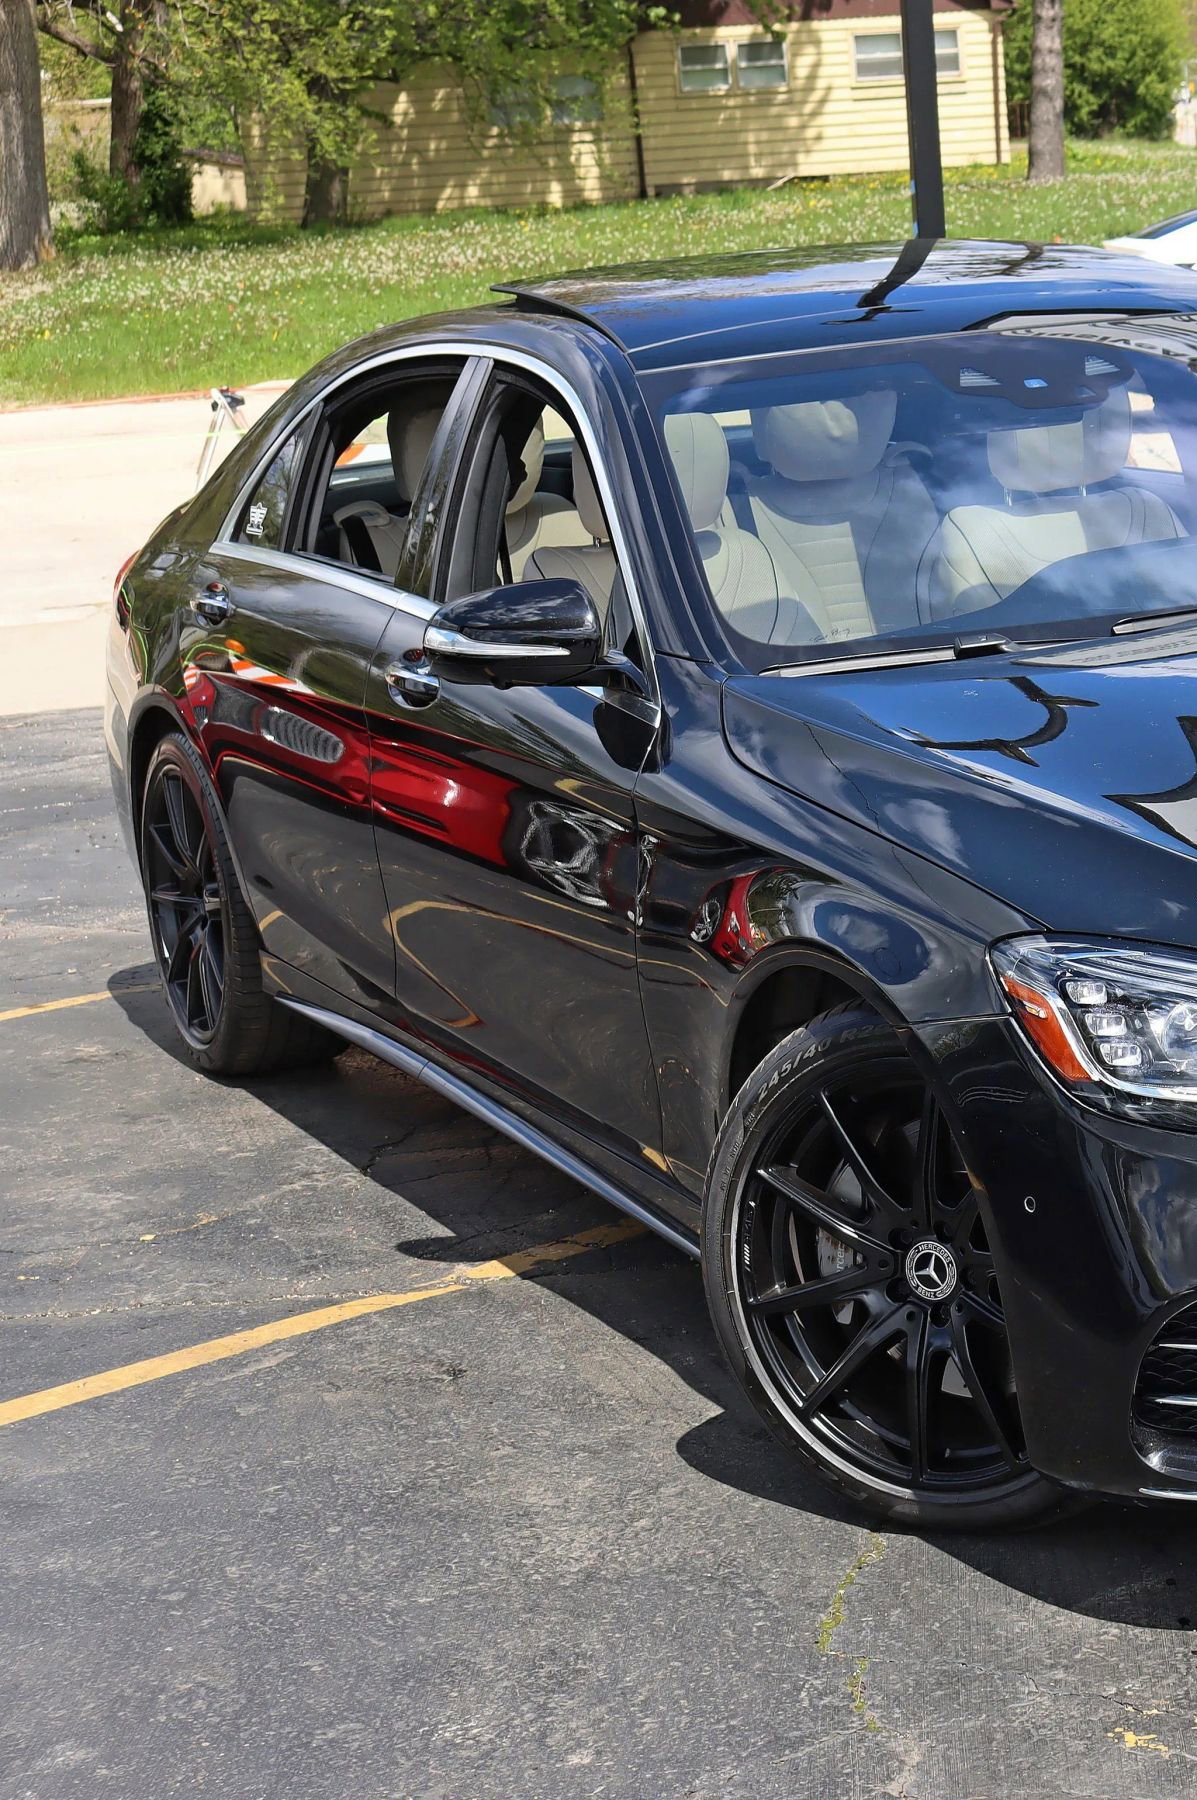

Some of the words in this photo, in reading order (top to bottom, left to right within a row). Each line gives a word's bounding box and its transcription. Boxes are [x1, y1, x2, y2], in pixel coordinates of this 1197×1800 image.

[757, 1037, 832, 1103] 245/40
[918, 1243, 952, 1263] MERCEDES
[917, 1287, 936, 1299] BENZ
